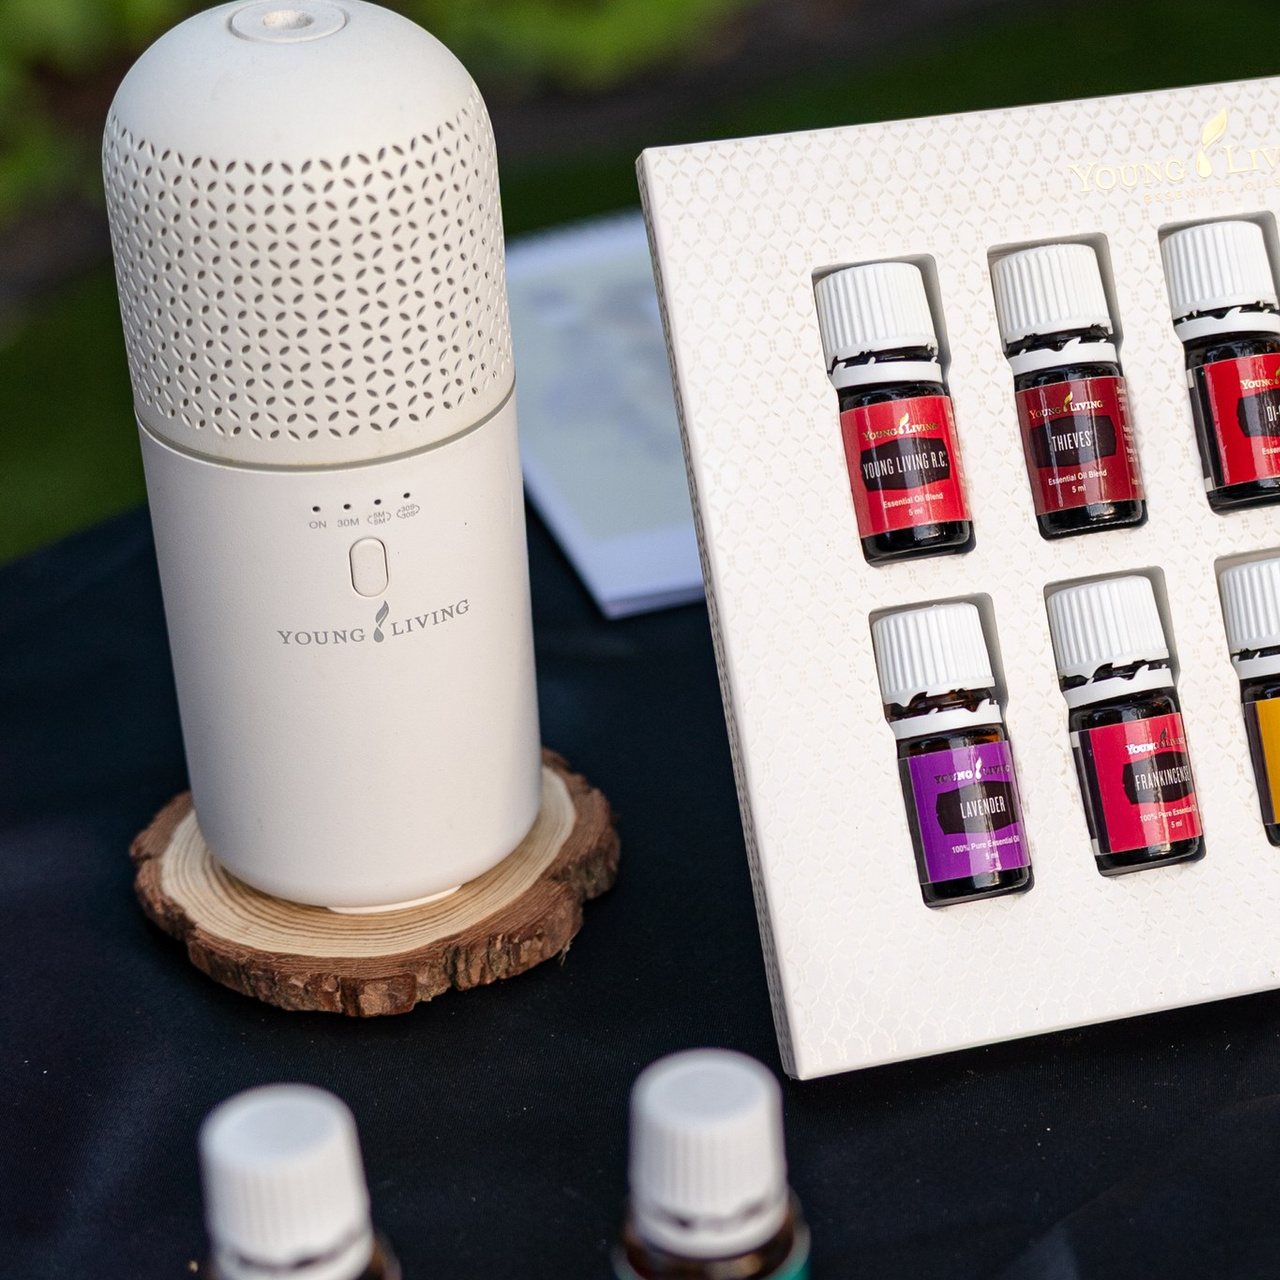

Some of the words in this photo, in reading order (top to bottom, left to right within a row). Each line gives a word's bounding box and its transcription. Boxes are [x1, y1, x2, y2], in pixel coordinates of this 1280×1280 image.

[1029, 406, 1061, 419] YOUNG
[1070, 400, 1103, 411] LIVING
[862, 428, 897, 441] YOUNG
[1051, 430, 1092, 453] THIEVES
[863, 458, 894, 479] YOUNG
[896, 453, 929, 473] LIVING
[1048, 473, 1077, 486] Essential
[1077, 472, 1087, 480] Oil
[1088, 469, 1107, 479] Blend
[1072, 485, 1077, 493] 5
[1077, 483, 1087, 492] ml
[883, 497, 913, 509] Essential
[925, 492, 943, 501] Blend
[909, 508, 914, 516] 5
[914, 507, 923, 515] ml
[309, 521, 327, 530] ON
[337, 518, 360, 528] 30M
[277, 629, 366, 646] YOUNG
[391, 599, 471, 637] LIVING
[1135, 765, 1191, 791] FRANKINCENSE
[960, 795, 1006, 819] LAVENDER
[1140, 812, 1158, 823] 100%
[1158, 810, 1172, 819] Pure
[1171, 820, 1175, 828] 5
[1175, 819, 1183, 827] ml
[952, 844, 970, 854] 100%
[971, 841, 986, 850] Pure
[987, 837, 1013, 848] Essential
[985, 852, 990, 860] 5
